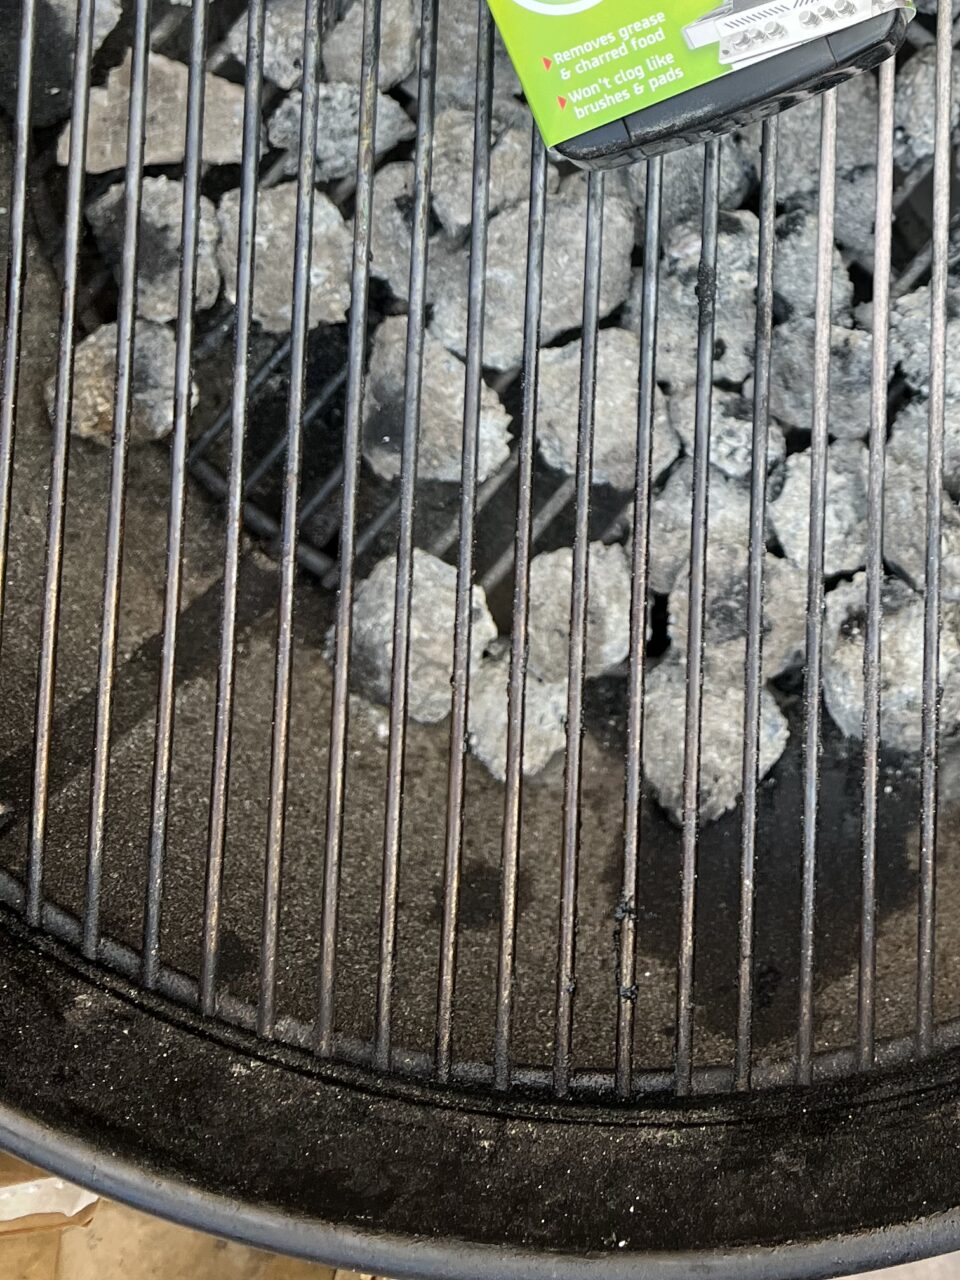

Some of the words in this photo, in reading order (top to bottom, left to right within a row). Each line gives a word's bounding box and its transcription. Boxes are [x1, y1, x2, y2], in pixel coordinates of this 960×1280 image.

[553, 32, 616, 65] Removes
[618, 11, 666, 41] grease
[560, 68, 571, 80] &
[575, 41, 629, 74] charred
[630, 27, 666, 51] food
[568, 77, 612, 103] Won't
[614, 65, 645, 85] clog
[646, 52, 675, 71] like
[574, 88, 630, 120] brushes
[633, 82, 644, 95] &
[648, 66, 684, 92] pads
